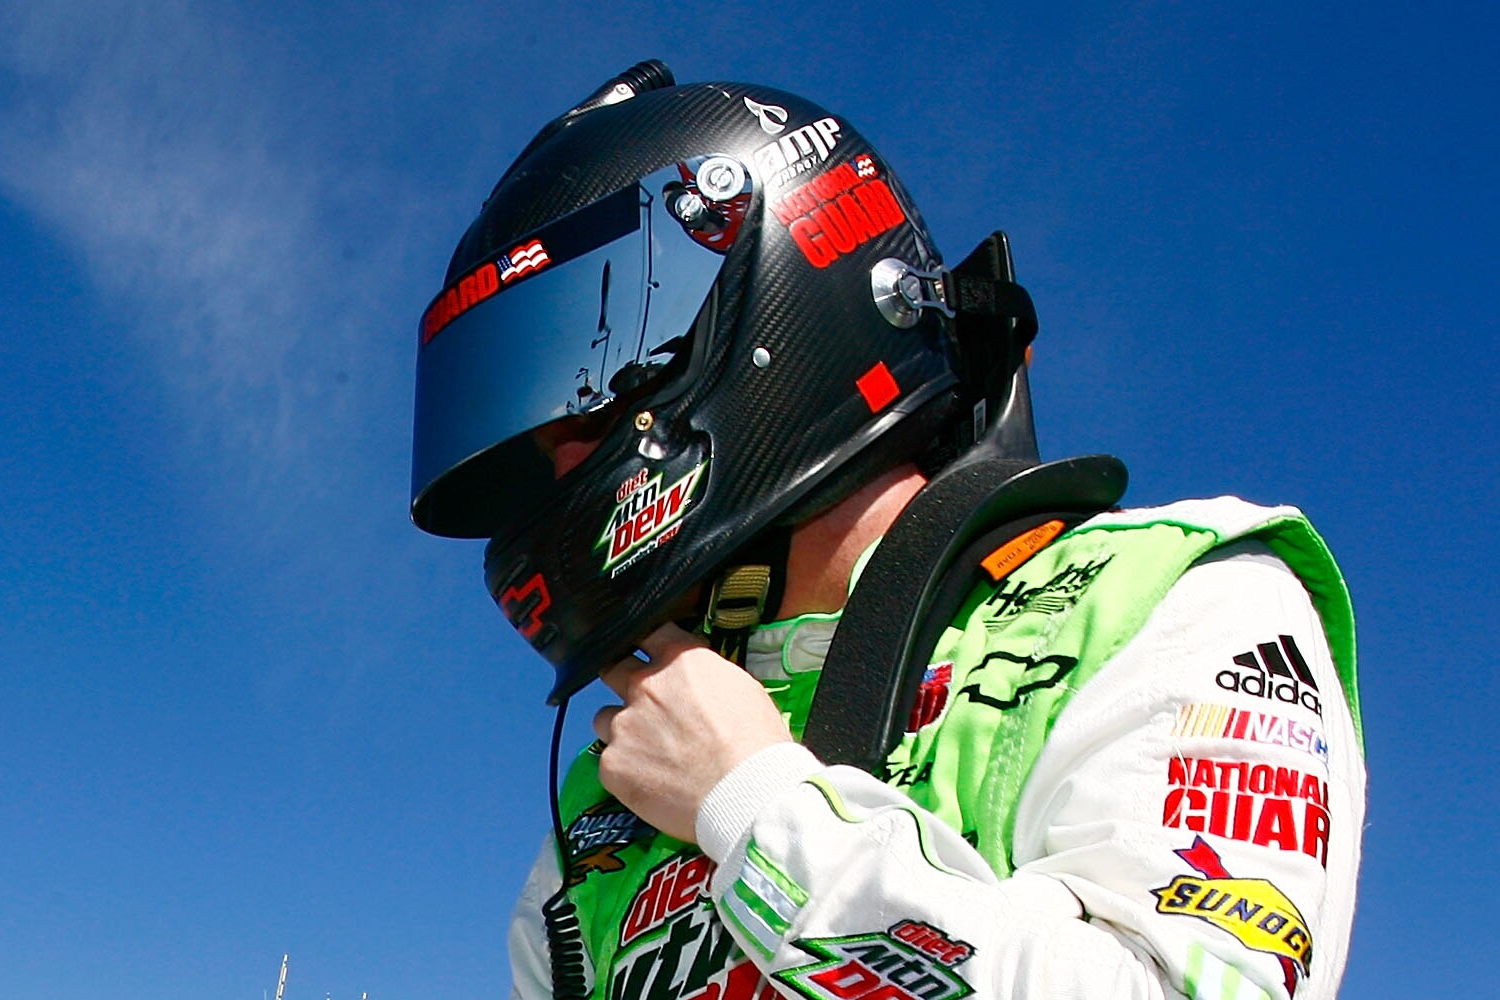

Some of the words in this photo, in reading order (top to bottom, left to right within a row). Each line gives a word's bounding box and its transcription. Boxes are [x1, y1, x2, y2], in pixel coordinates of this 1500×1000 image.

[769, 162, 864, 227] NATIONAL
[790, 179, 906, 268] GUARD
[617, 468, 648, 503] diet
[1216, 669, 1322, 718] adida
[624, 855, 718, 941] die
[894, 922, 970, 964] diet
